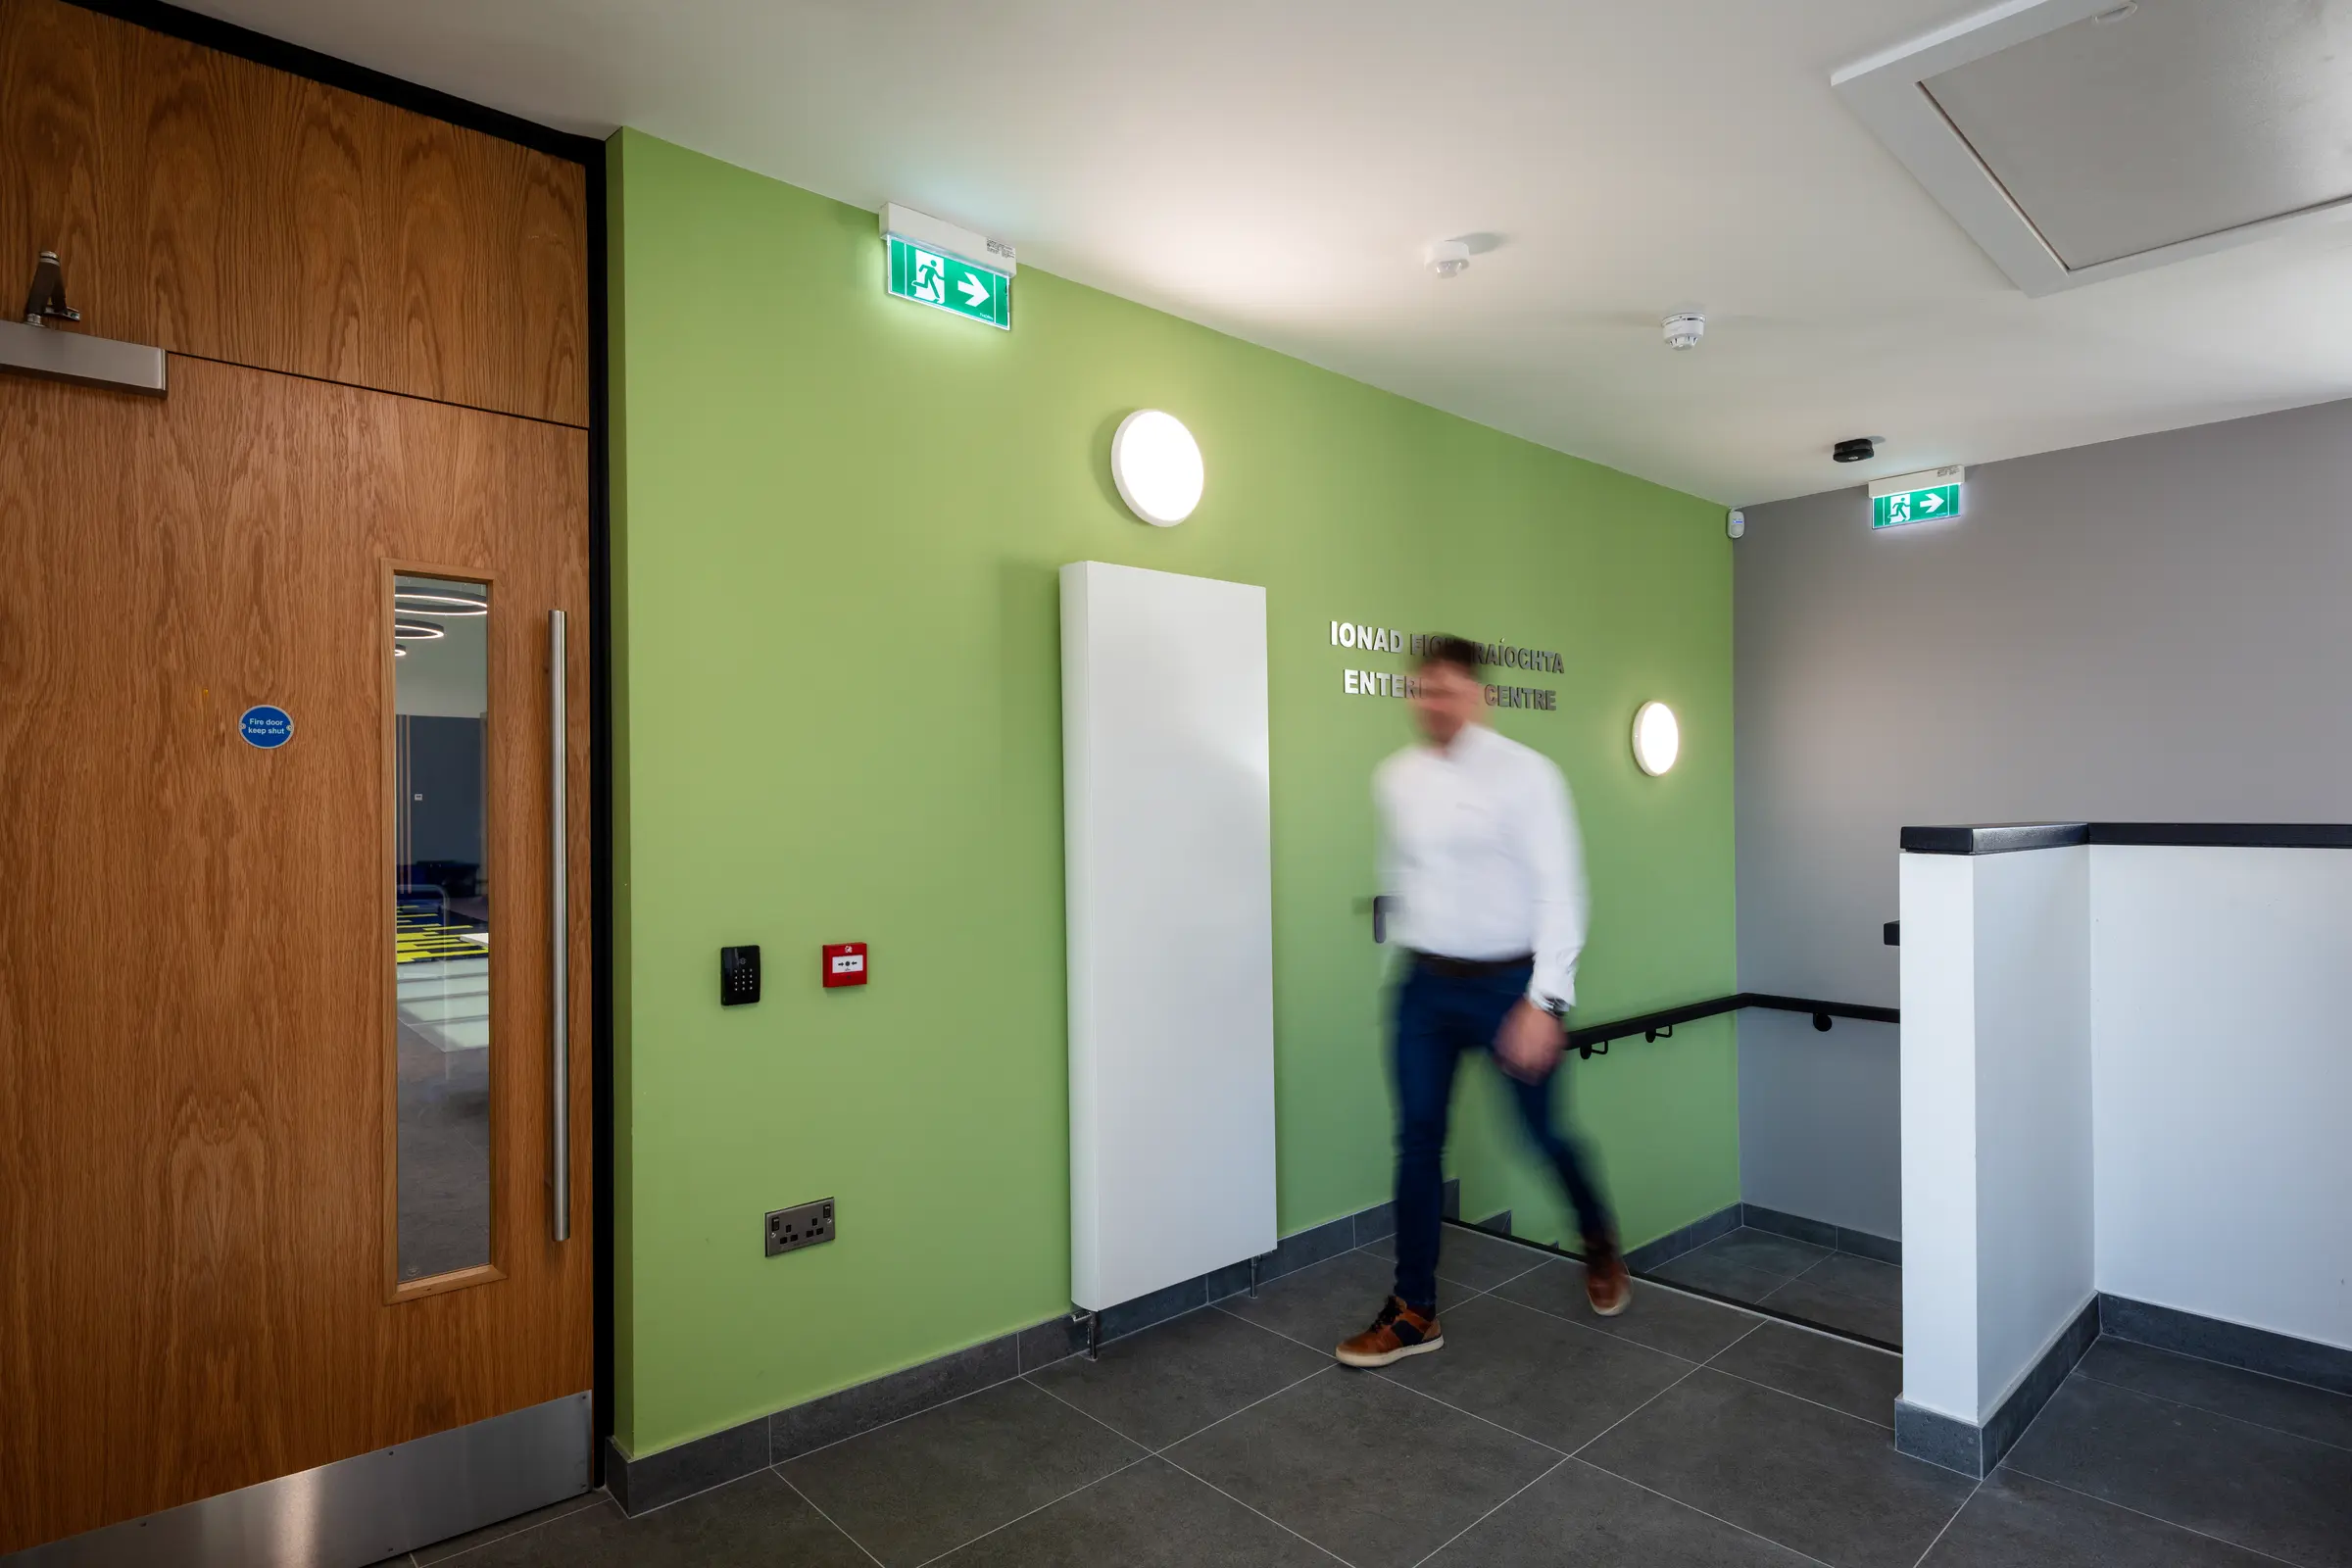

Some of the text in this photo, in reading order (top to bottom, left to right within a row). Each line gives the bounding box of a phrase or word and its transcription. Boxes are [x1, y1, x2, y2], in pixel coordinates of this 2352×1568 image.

[1330, 620, 1564, 673] IONAD FIORAÍOCHTA
[1485, 684, 1557, 710] CENTRE
